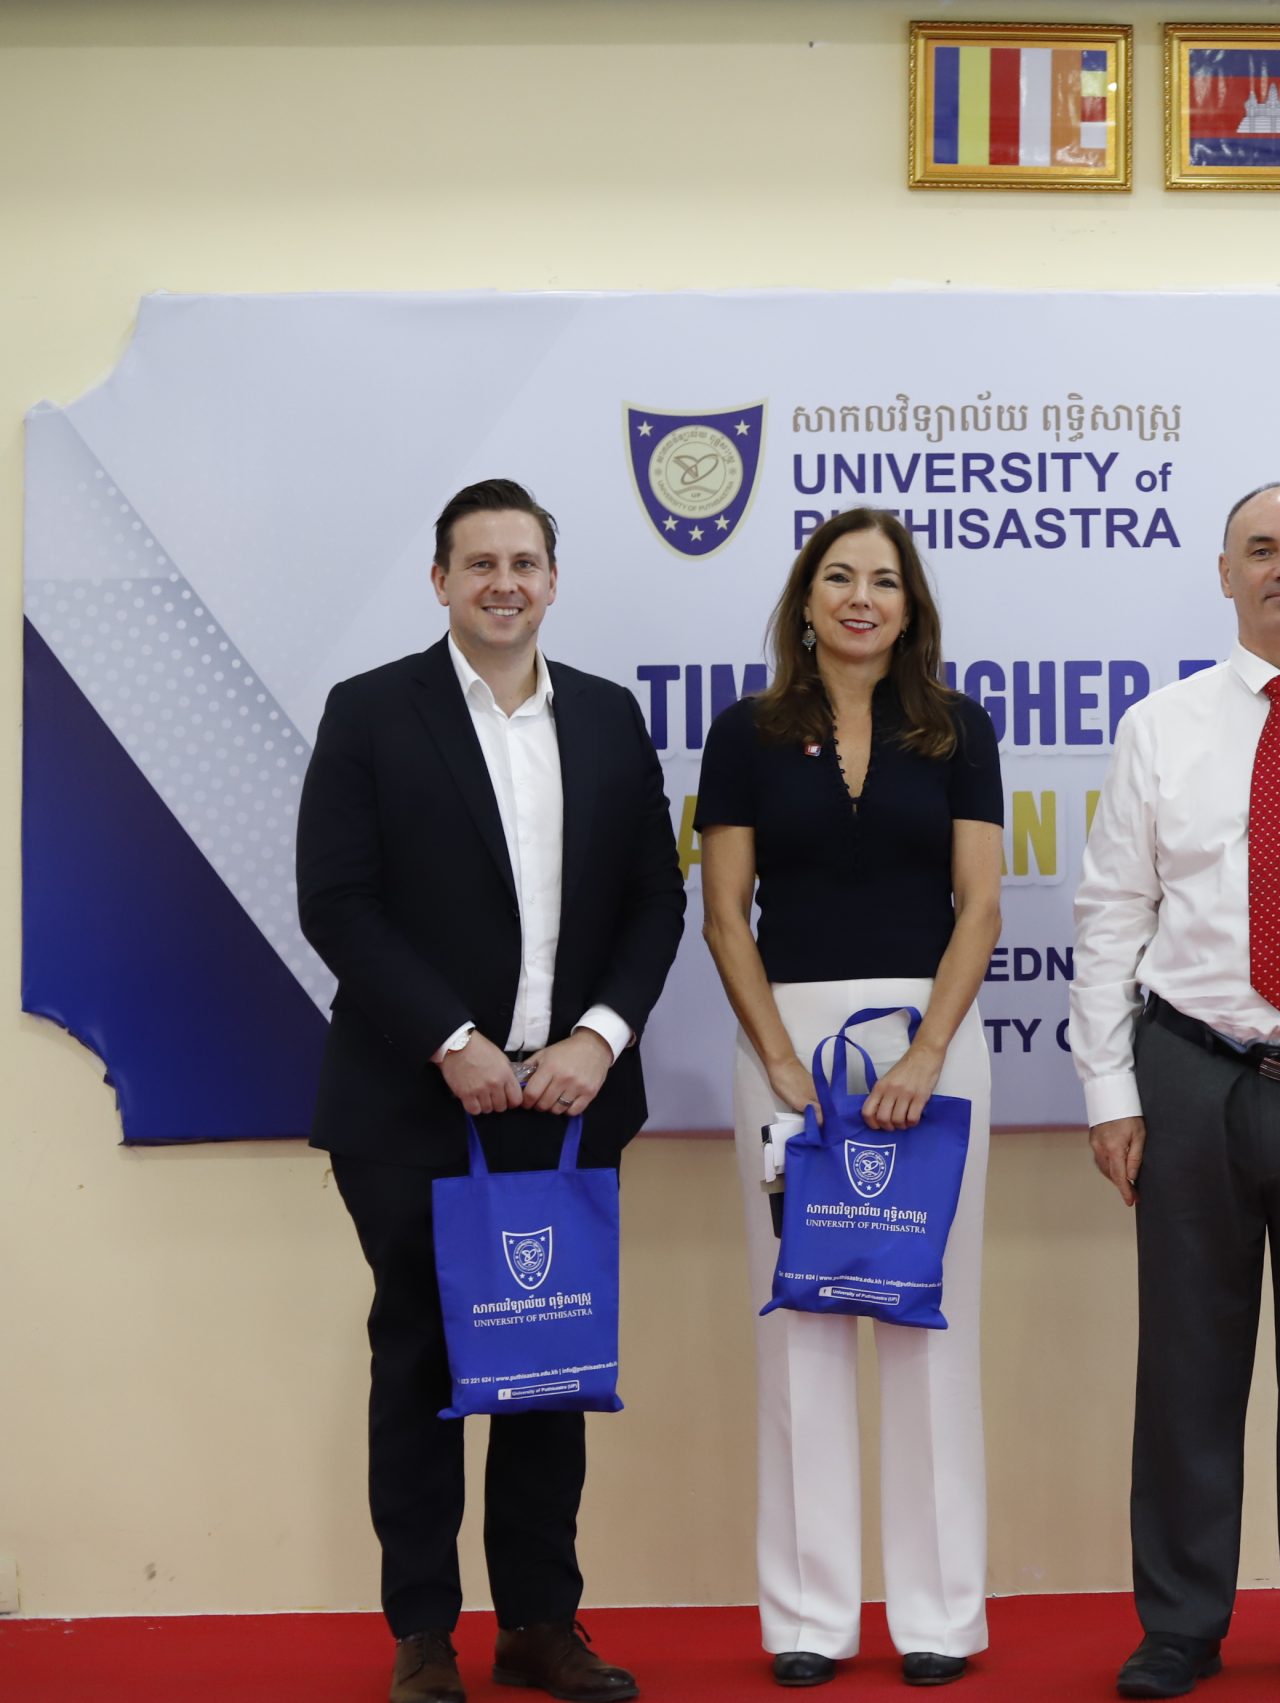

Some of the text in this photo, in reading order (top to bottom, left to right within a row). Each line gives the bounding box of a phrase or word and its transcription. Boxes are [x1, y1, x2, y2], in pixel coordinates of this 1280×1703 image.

[791, 391, 1028, 443] សាកលវិទ្យាល័យ
[793, 452, 1173, 495] UNIVERSITY of
[794, 508, 1181, 550] PHISASTRA
[943, 660, 1150, 746] GHER
[806, 1218, 926, 1234] UNIVERSITY OF PUTHISASTRA
[474, 1308, 592, 1328] UNIVERSITY OF PUTHISASTRA
